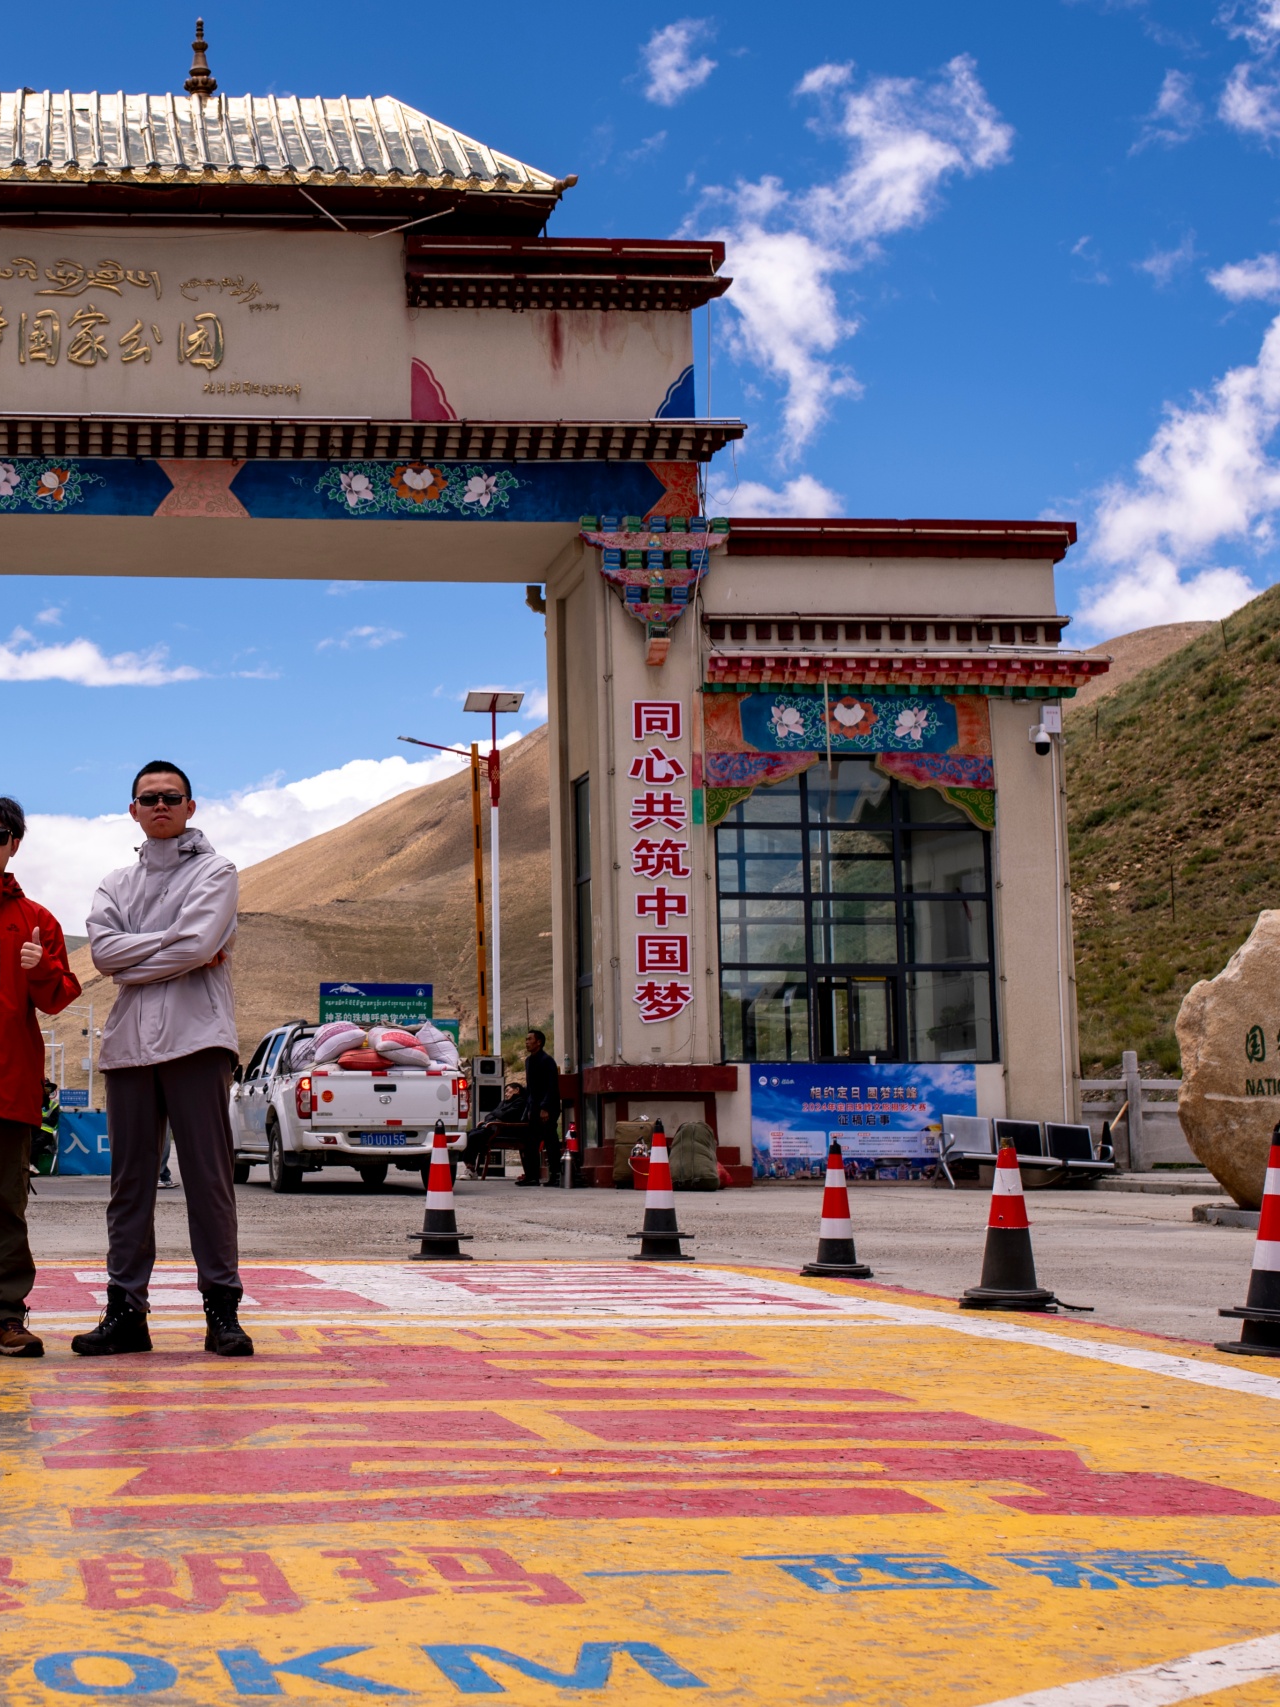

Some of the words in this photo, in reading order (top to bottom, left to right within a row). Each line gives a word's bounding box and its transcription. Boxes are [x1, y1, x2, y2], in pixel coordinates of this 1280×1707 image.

[627, 700, 694, 1023] 同心共筑中国梦
[809, 1086, 861, 1101] 相约定日
[867, 1086, 919, 1101] 圆梦珠峰
[1246, 1078, 1280, 1096] NATI
[838, 1114, 891, 1126] 征稿启事
[64, 1132, 110, 1154] 入口
[452, 1327, 705, 1341] LIFE
